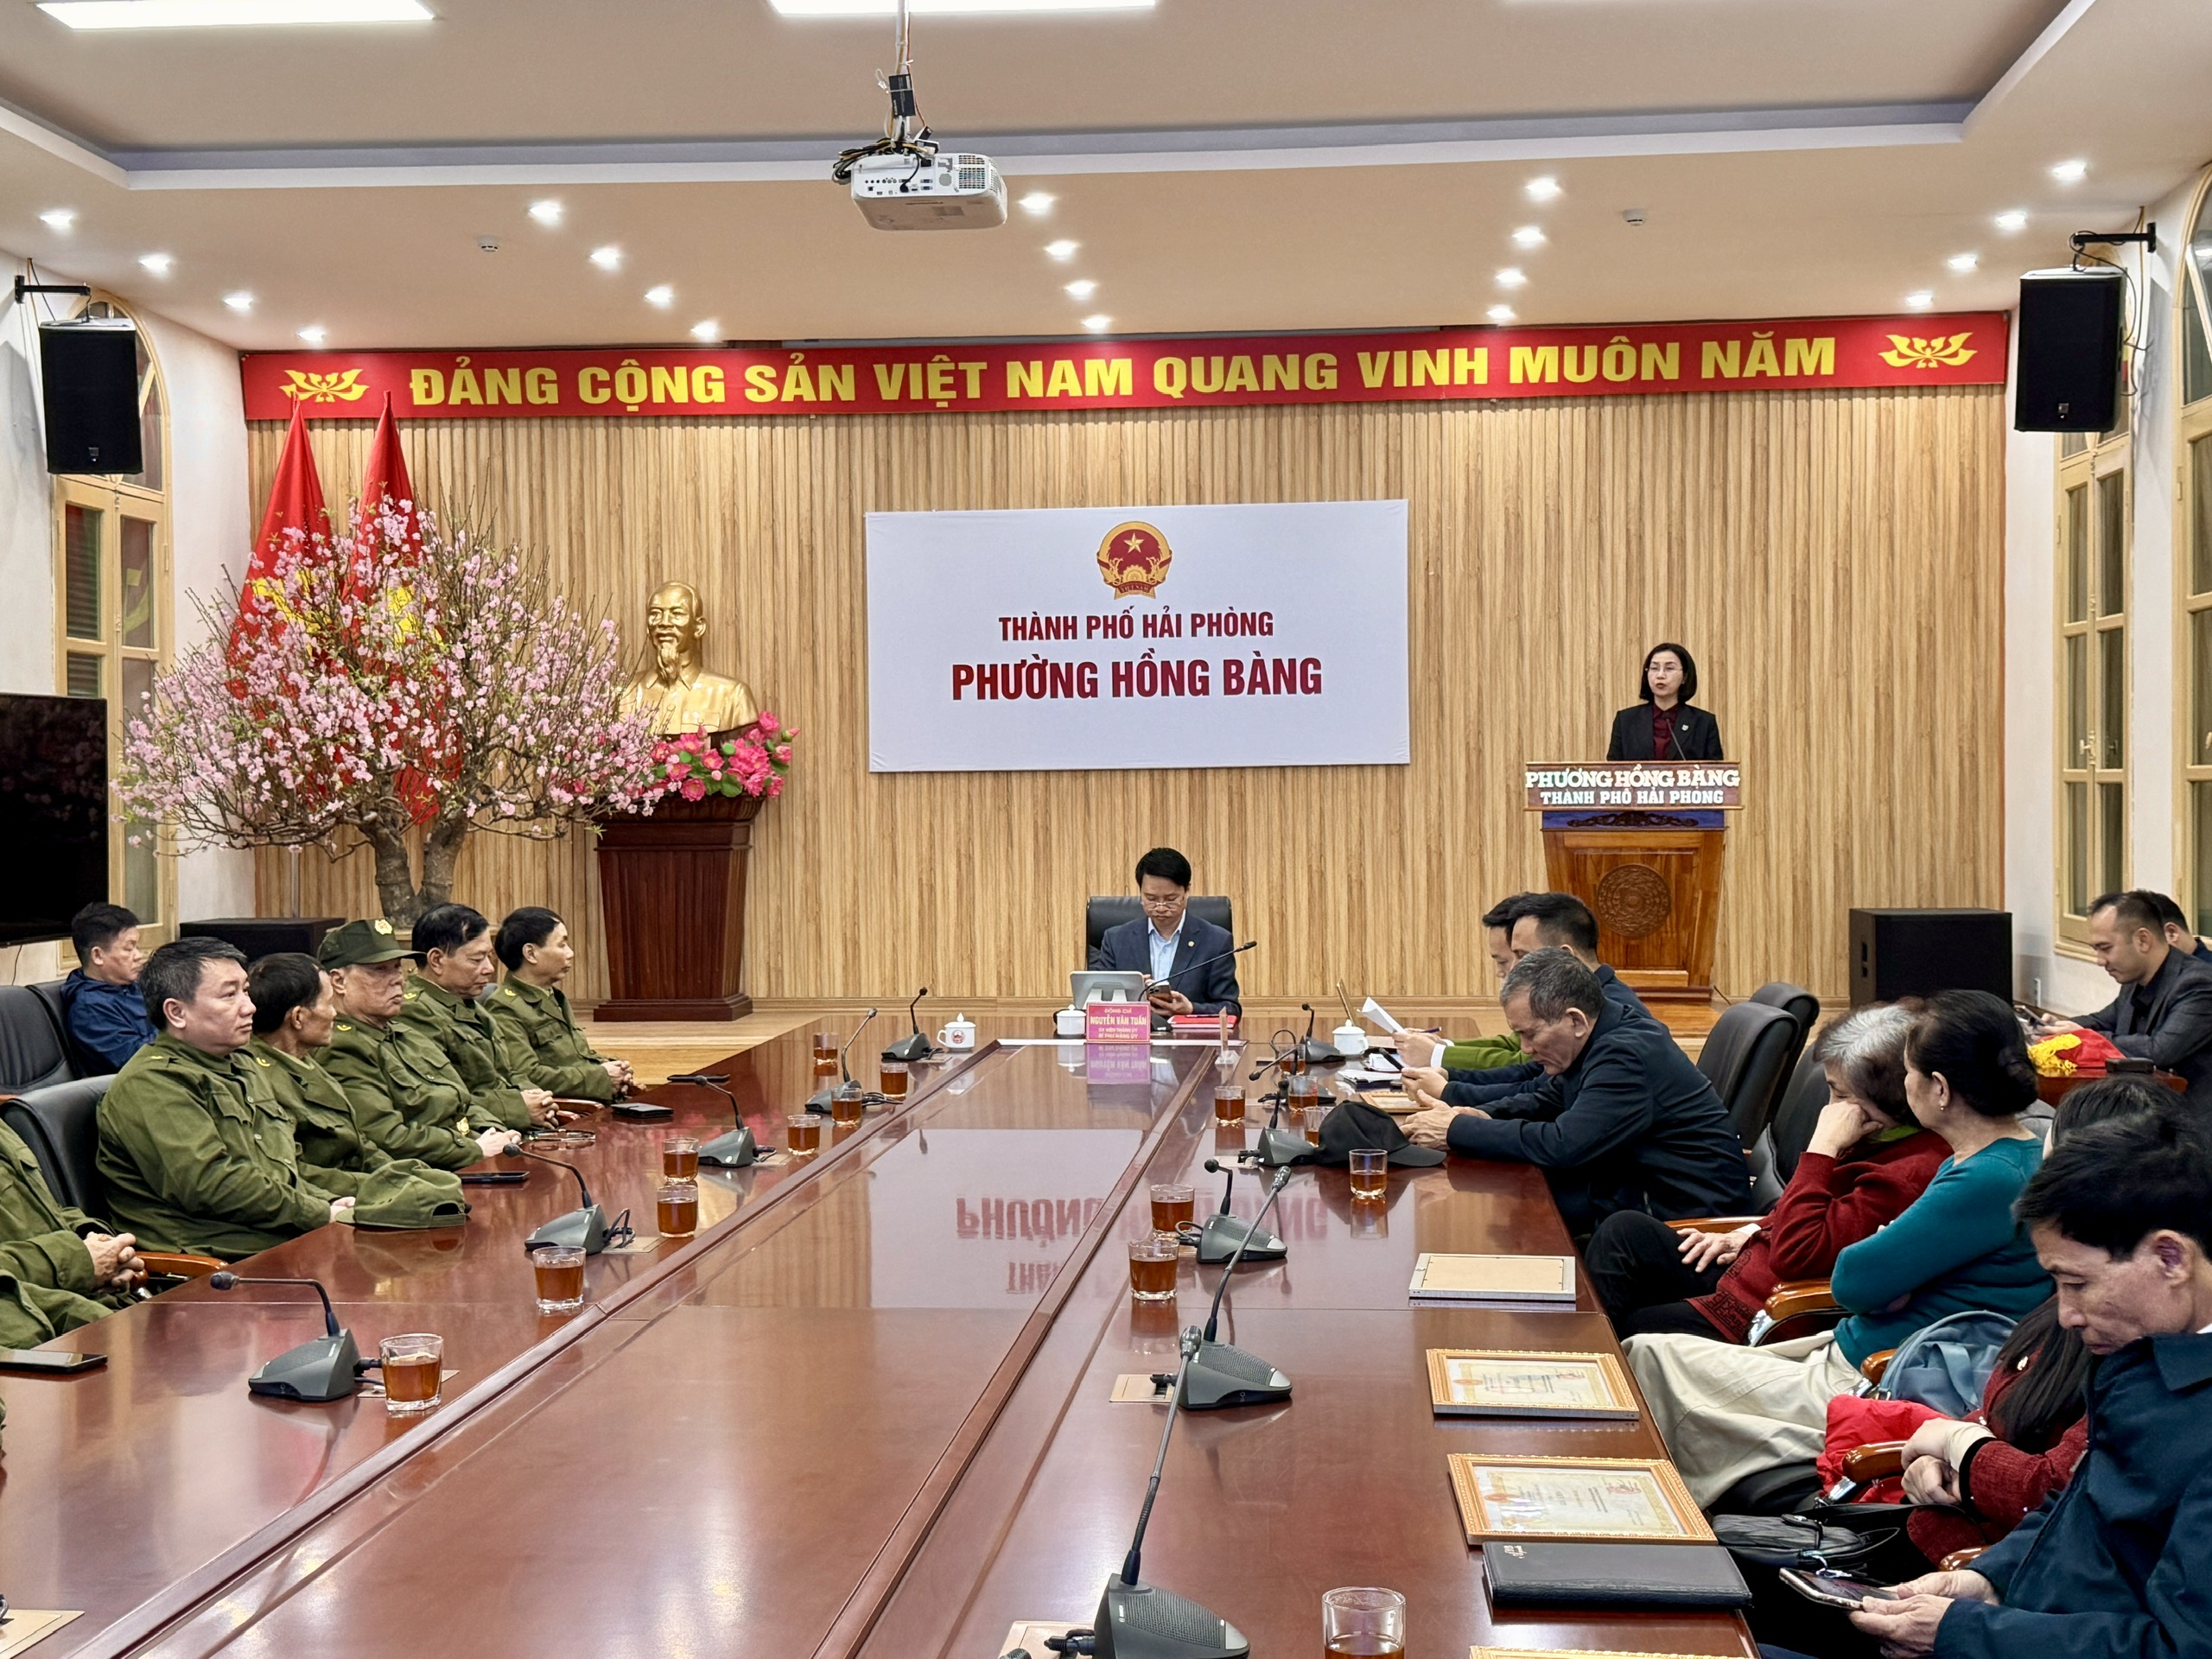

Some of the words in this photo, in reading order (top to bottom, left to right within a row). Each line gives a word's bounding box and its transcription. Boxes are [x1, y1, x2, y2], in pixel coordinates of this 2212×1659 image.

[410, 356, 559, 406] ĐẢNG
[577, 359, 726, 412] CỘNG
[744, 352, 855, 403] SẢN
[873, 354, 988, 408] VIỆT
[1007, 358, 1133, 398] NAM
[1153, 353, 1338, 398] QUANG
[1357, 347, 1489, 389] VINH
[1510, 335, 1680, 384] MUÔN
[1700, 331, 1836, 378] NĂM
[999, 611, 1078, 640] THÀNH
[1086, 605, 1135, 639] PHỐ
[1142, 605, 1182, 638] HẢI
[1191, 607, 1274, 637] PHÒNG
[952, 653, 1098, 701] PHƯỜNG
[1111, 647, 1210, 697] HỒNG
[1223, 651, 1323, 696] BÀNG
[1676, 764, 1741, 787] BÀNG
